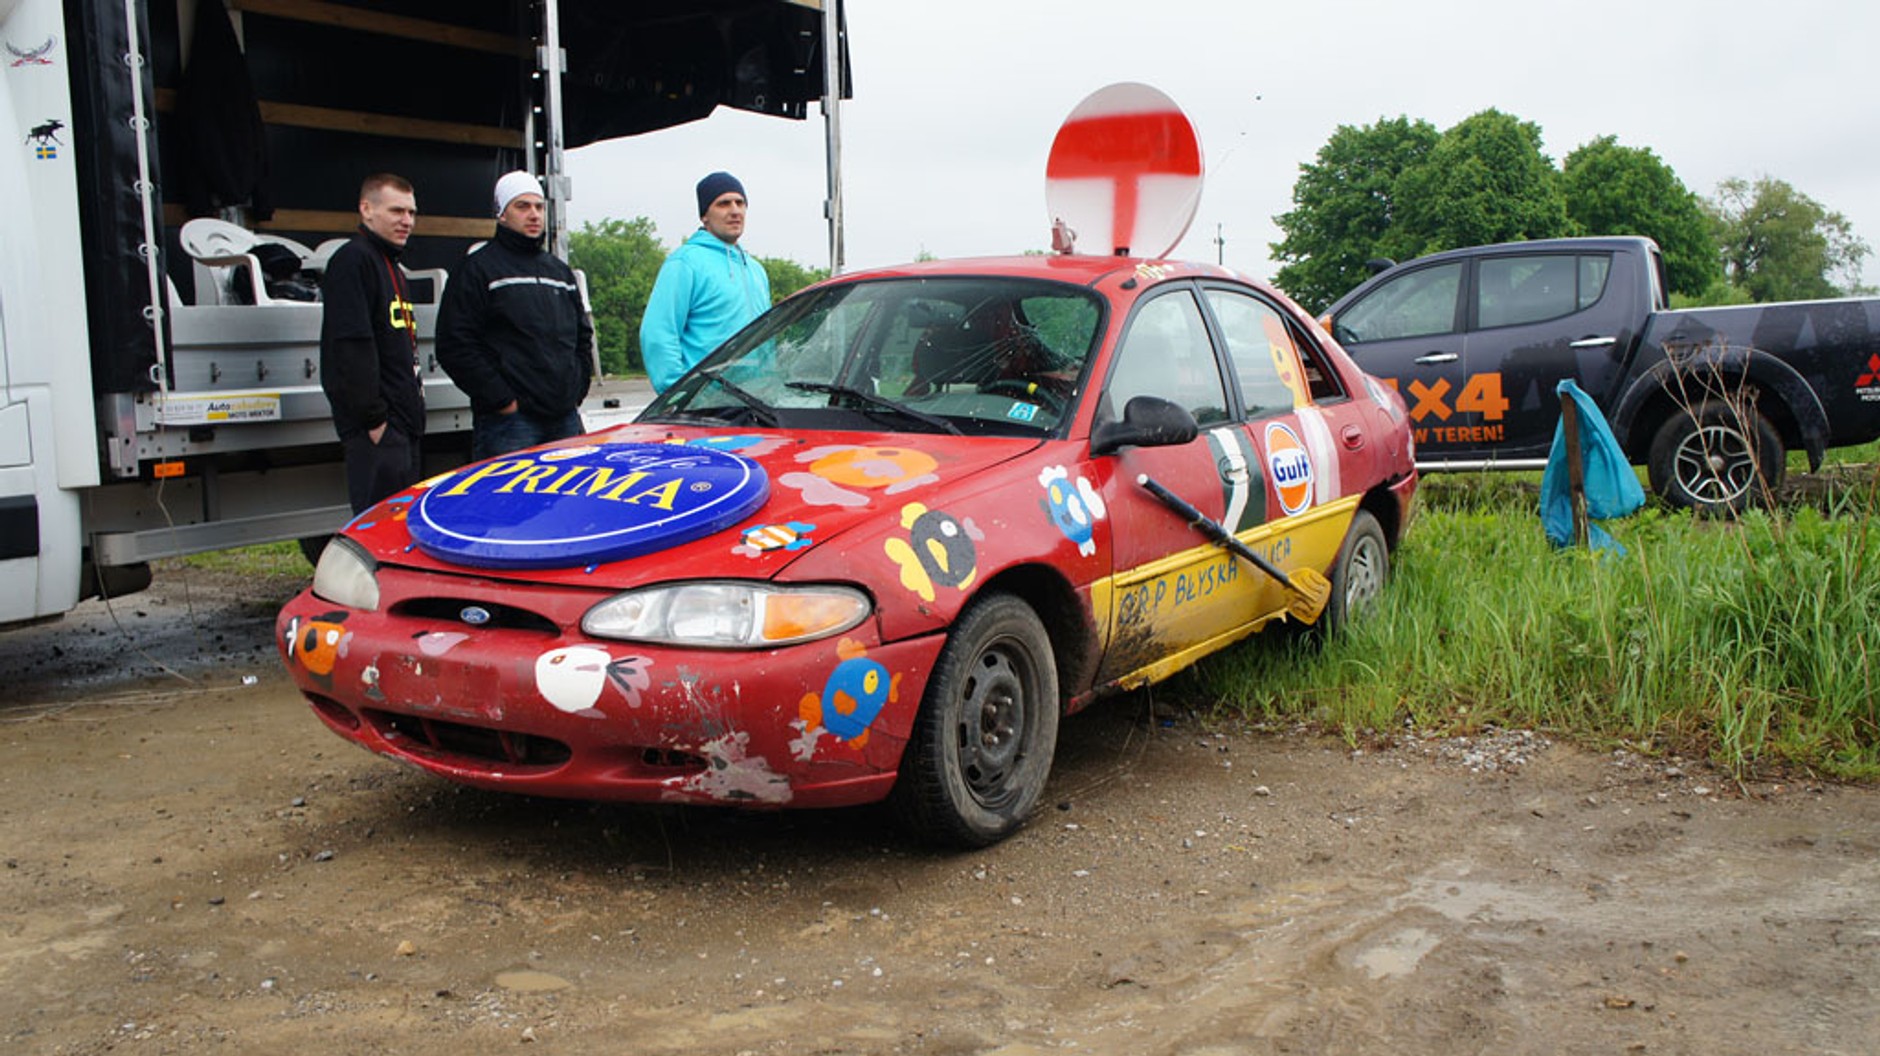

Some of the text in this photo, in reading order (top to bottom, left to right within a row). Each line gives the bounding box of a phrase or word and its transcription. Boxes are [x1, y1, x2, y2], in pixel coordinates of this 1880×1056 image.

[1433, 424, 1505, 442] TEREN!
[1273, 454, 1308, 482] Gulf
[436, 459, 684, 511] PRIMA
